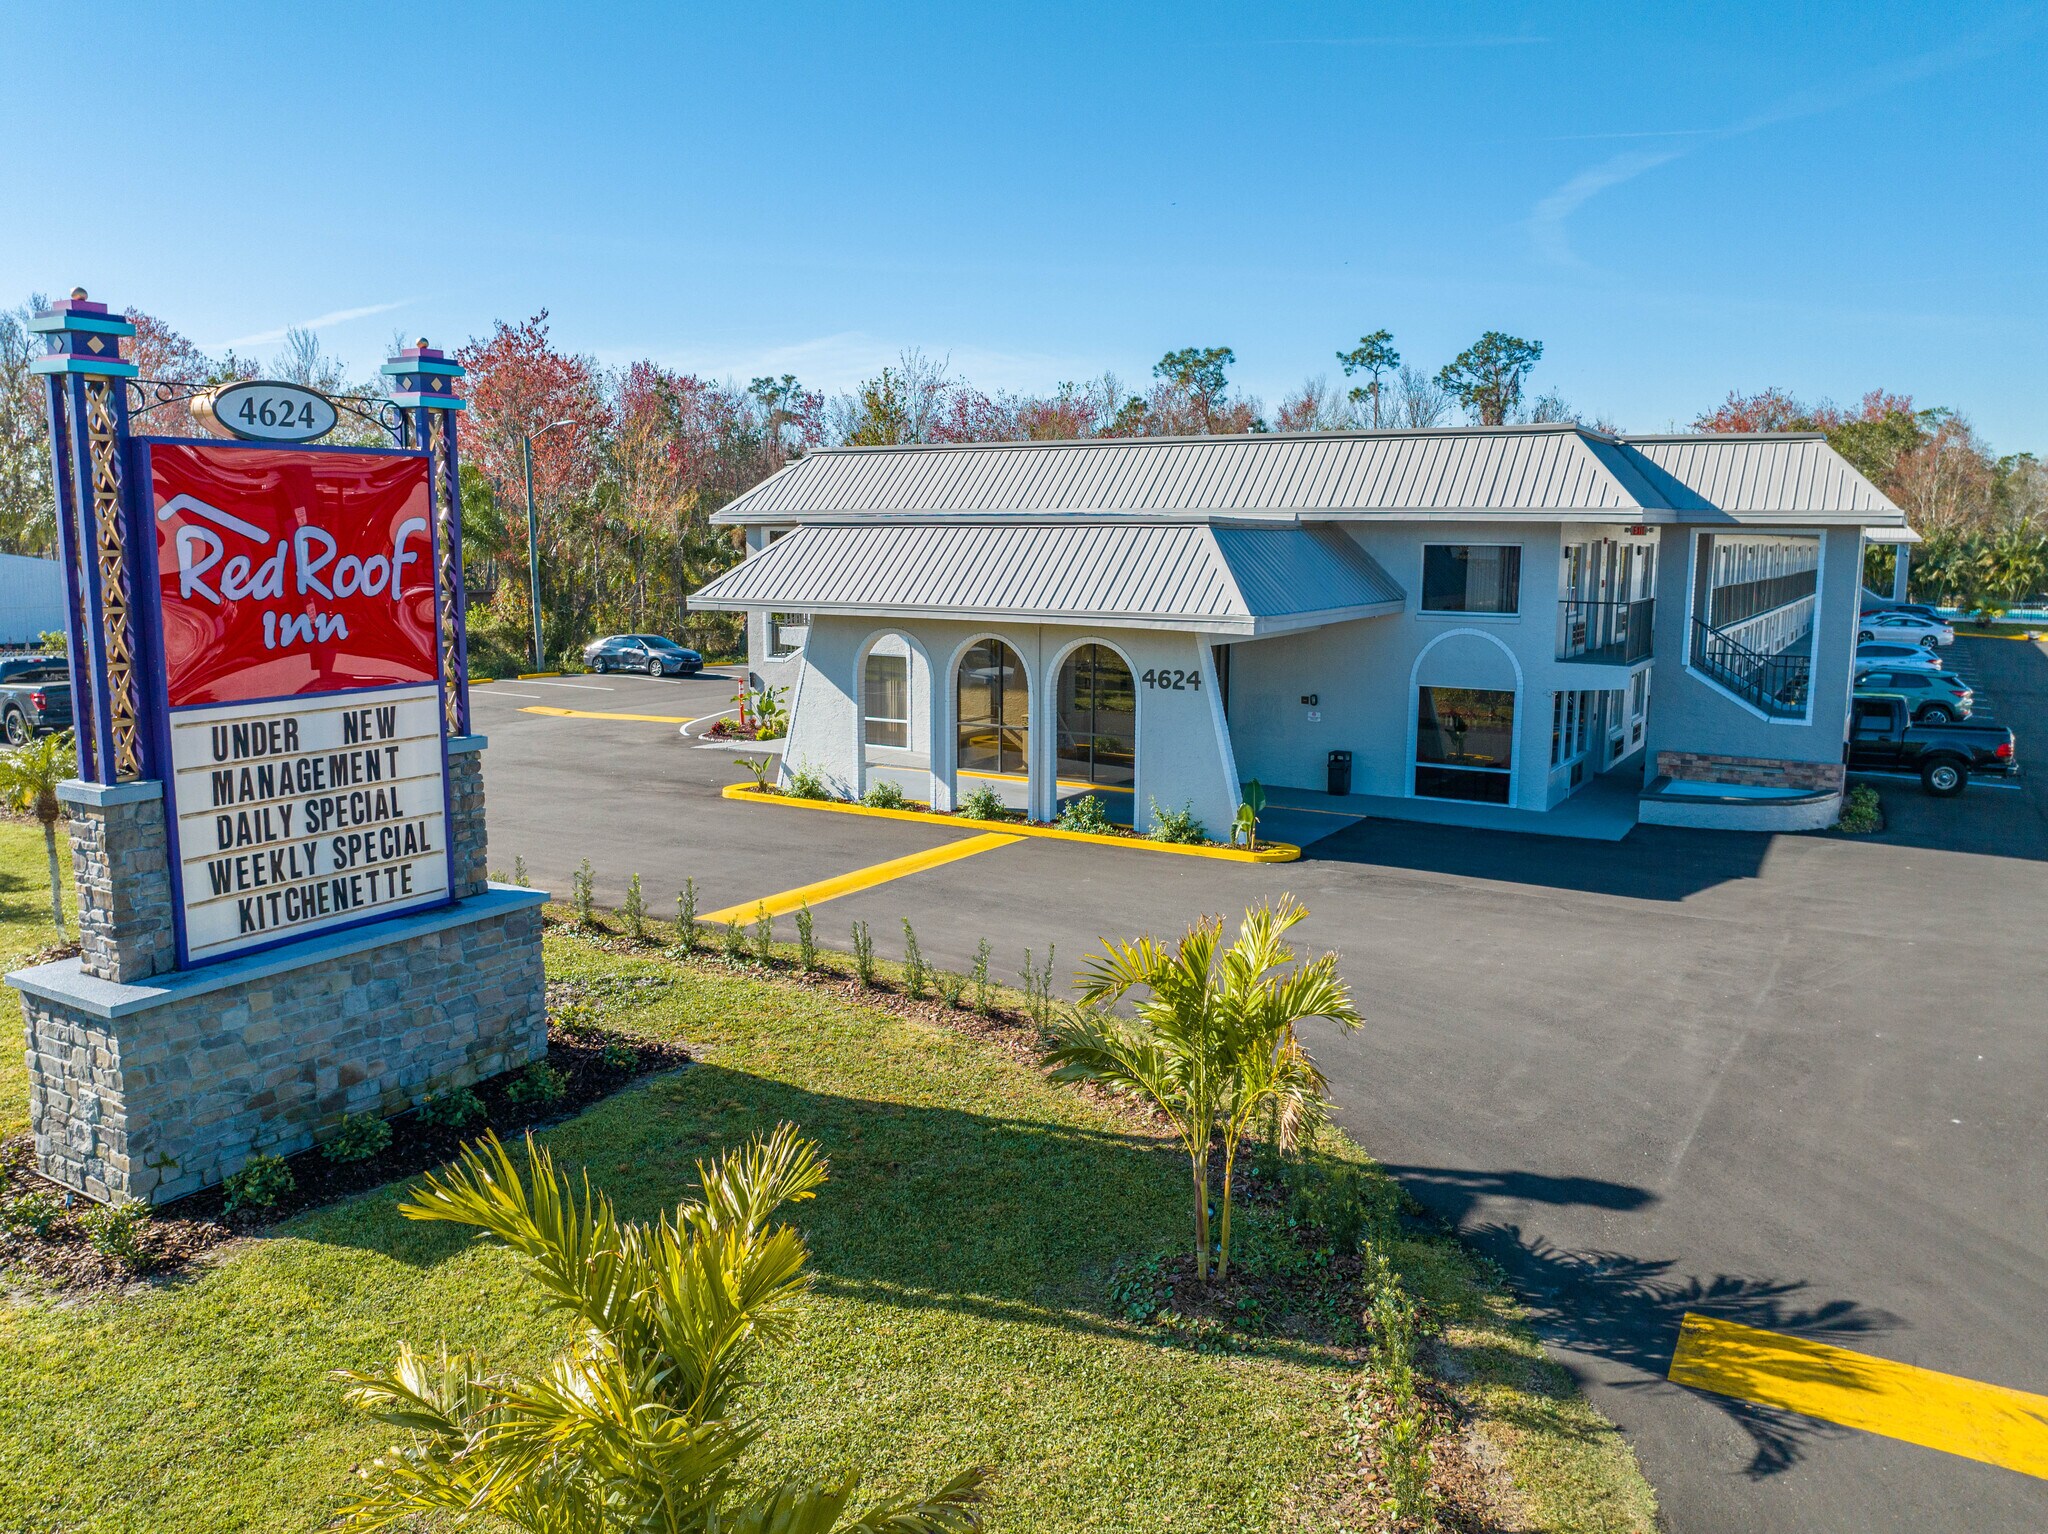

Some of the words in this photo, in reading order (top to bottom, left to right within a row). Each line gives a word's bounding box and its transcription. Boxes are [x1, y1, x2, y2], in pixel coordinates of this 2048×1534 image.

[238, 396, 315, 429] 4624
[176, 524, 288, 605] Red
[294, 517, 427, 600] Roof
[1142, 669, 1201, 691] 4624
[212, 718, 299, 762] UNDER
[342, 705, 396, 745] NEW
[211, 746, 399, 807] MANAGEMENT
[217, 804, 293, 850] DAILY
[304, 786, 403, 834] SPECIAL
[208, 841, 317, 896] WEEKLY
[332, 821, 431, 870] SPECIAL
[238, 863, 413, 934] KITCHENETTE
